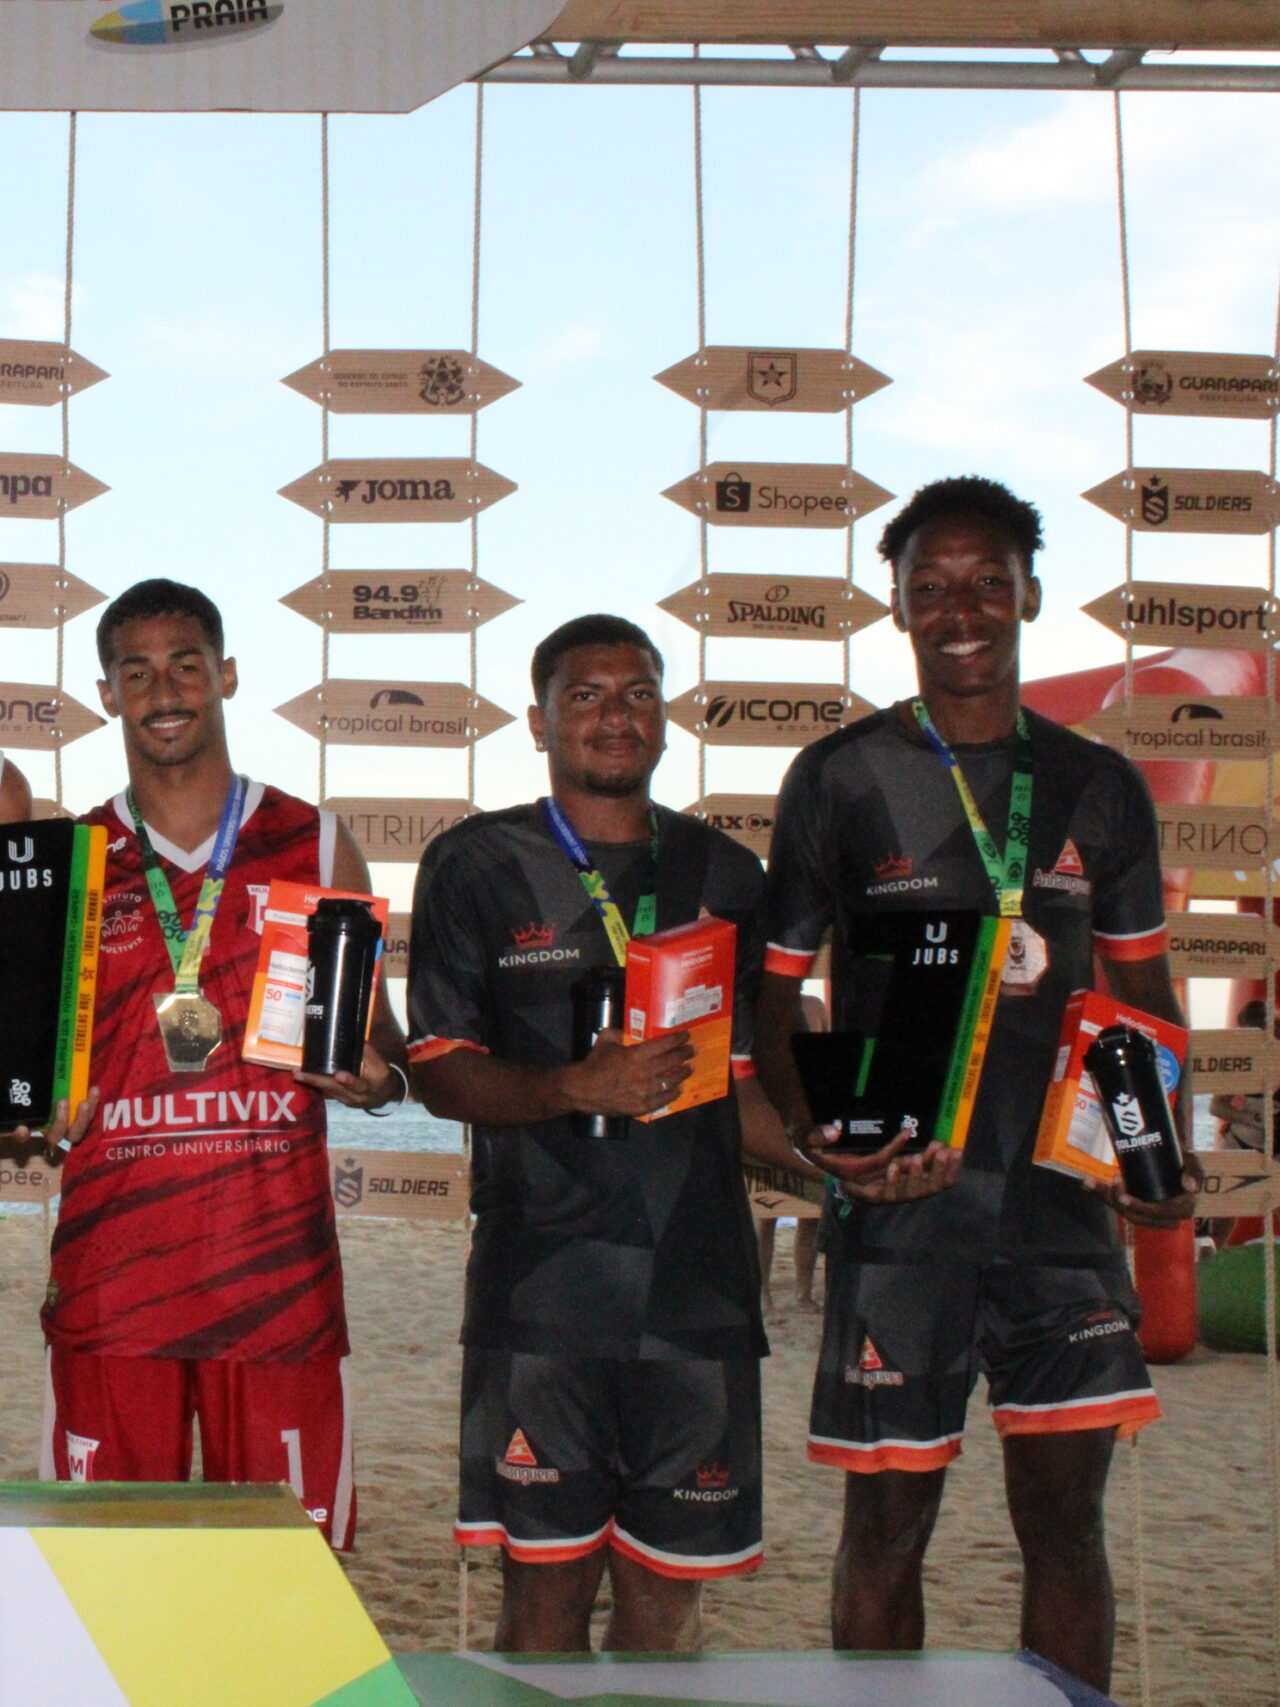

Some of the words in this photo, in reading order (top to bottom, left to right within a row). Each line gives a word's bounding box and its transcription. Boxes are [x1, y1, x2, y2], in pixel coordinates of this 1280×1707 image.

[170, 0, 268, 31] PRAIA
[1179, 376, 1279, 393] GUARAPARI
[757, 486, 849, 516] Shopee
[1174, 495, 1252, 512] SOLDIERS
[352, 584, 419, 603] 94.9
[727, 600, 825, 629] SPALDING
[1126, 597, 1268, 634] uhlsport
[320, 713, 403, 734] tropical
[410, 715, 468, 736] brasil
[1125, 728, 1204, 749] tropical
[1209, 728, 1266, 747] brasil
[866, 876, 938, 897] KINGDOM
[912, 948, 959, 966] JUBS
[1170, 937, 1266, 956] GUARAPARI
[498, 948, 580, 968] KINGDOM
[265, 989, 282, 1001] 50
[11, 1078, 31, 1094] 20
[13, 1091, 32, 1107] 26
[102, 1090, 297, 1131] MULTIVIX
[105, 1143, 166, 1161] CENTRO
[172, 1136, 291, 1155] UNIVERSITÁRIO
[1115, 1131, 1162, 1150] SOLDIERS
[368, 1176, 450, 1197] SOLDIERS
[1068, 1319, 1130, 1343] KINGDOM
[280, 1428, 304, 1499] 1
